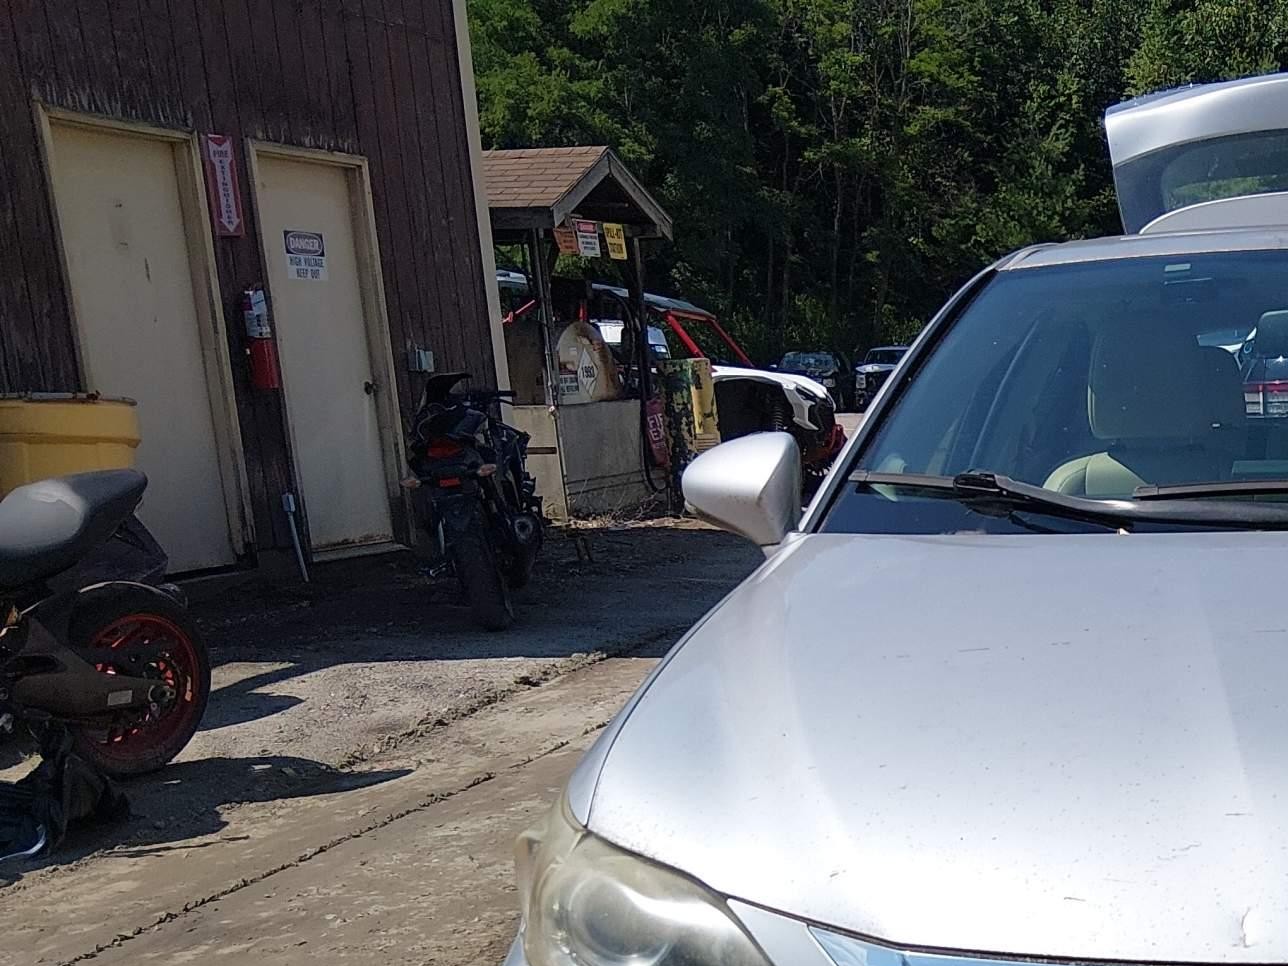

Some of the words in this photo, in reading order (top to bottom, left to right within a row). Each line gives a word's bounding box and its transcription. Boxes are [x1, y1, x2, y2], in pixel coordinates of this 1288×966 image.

[213, 149, 229, 158] FIRE
[289, 236, 320, 251] DANGER
[289, 256, 302, 266] HIGH
[304, 256, 324, 268] VOLTAGE
[296, 268, 308, 278] KEEP
[310, 269, 321, 279] OUT
